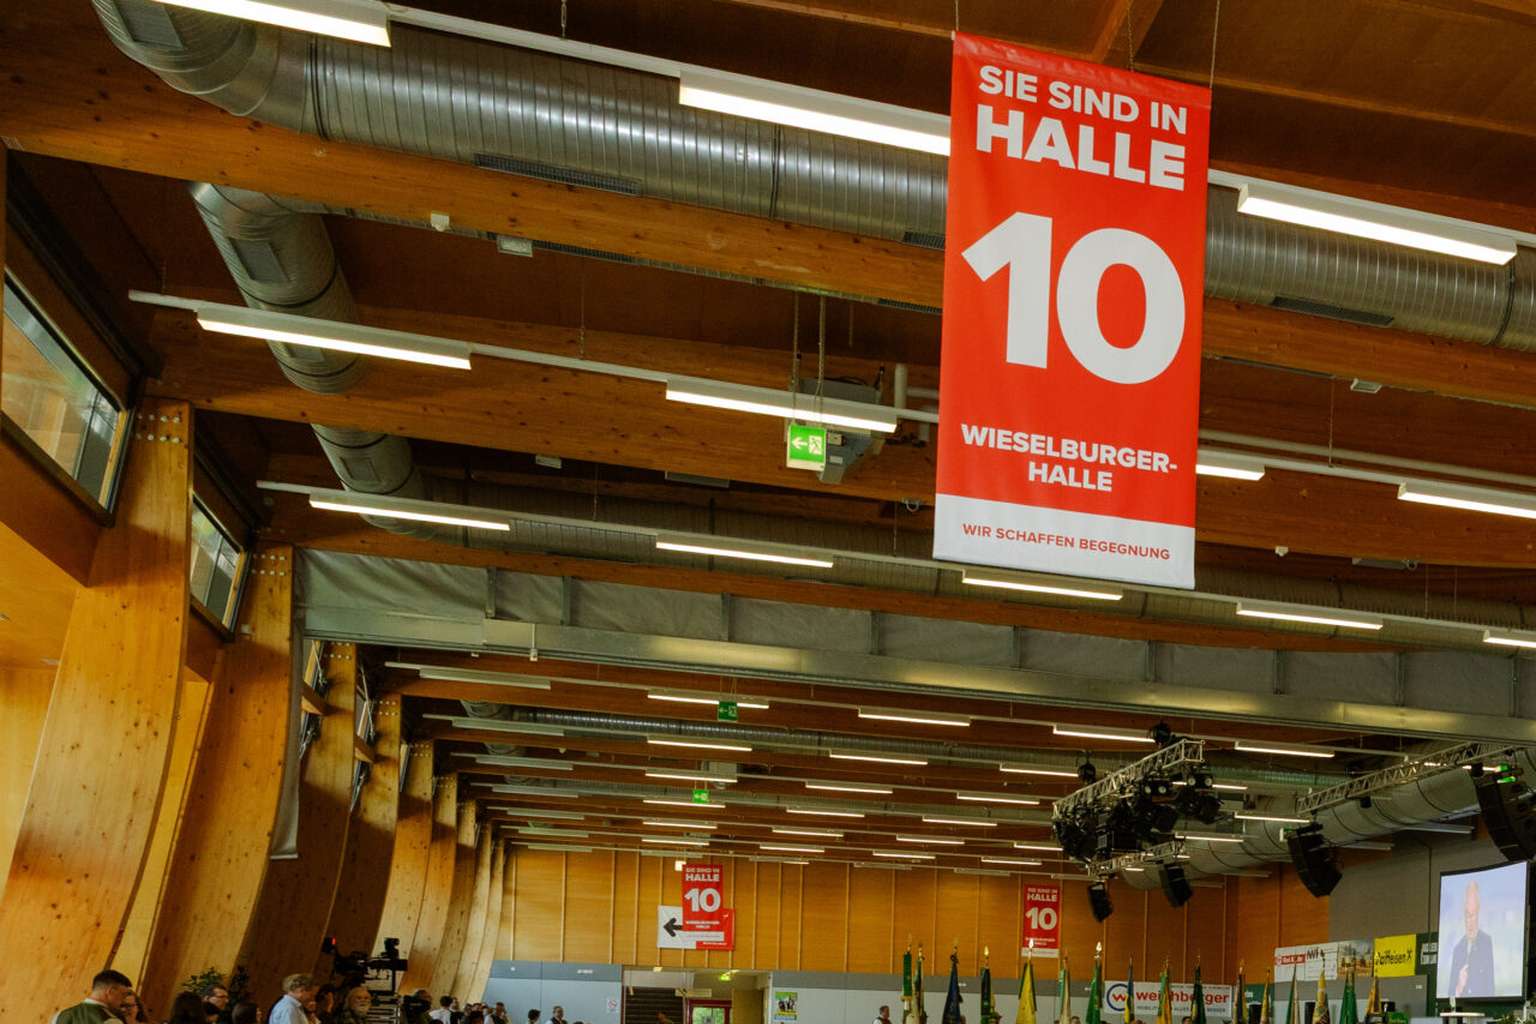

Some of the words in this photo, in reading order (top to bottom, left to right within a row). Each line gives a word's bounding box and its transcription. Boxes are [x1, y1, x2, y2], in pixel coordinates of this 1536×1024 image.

[978, 65, 1038, 103] SIE
[1048, 81, 1140, 122] SIND
[1150, 101, 1188, 135] IN
[976, 103, 1186, 192] HALLE
[961, 210, 1186, 385] 10
[961, 424, 1178, 474] WIESELBURGER-
[1028, 460, 1113, 493] HALLE
[962, 523, 992, 540] WIR
[995, 527, 1076, 551] SCHAFFEN
[1079, 537, 1171, 561] BEGEGNUNG
[685, 873, 721, 882] HALLE
[684, 888, 721, 912] 10
[1025, 907, 1058, 930] 10
